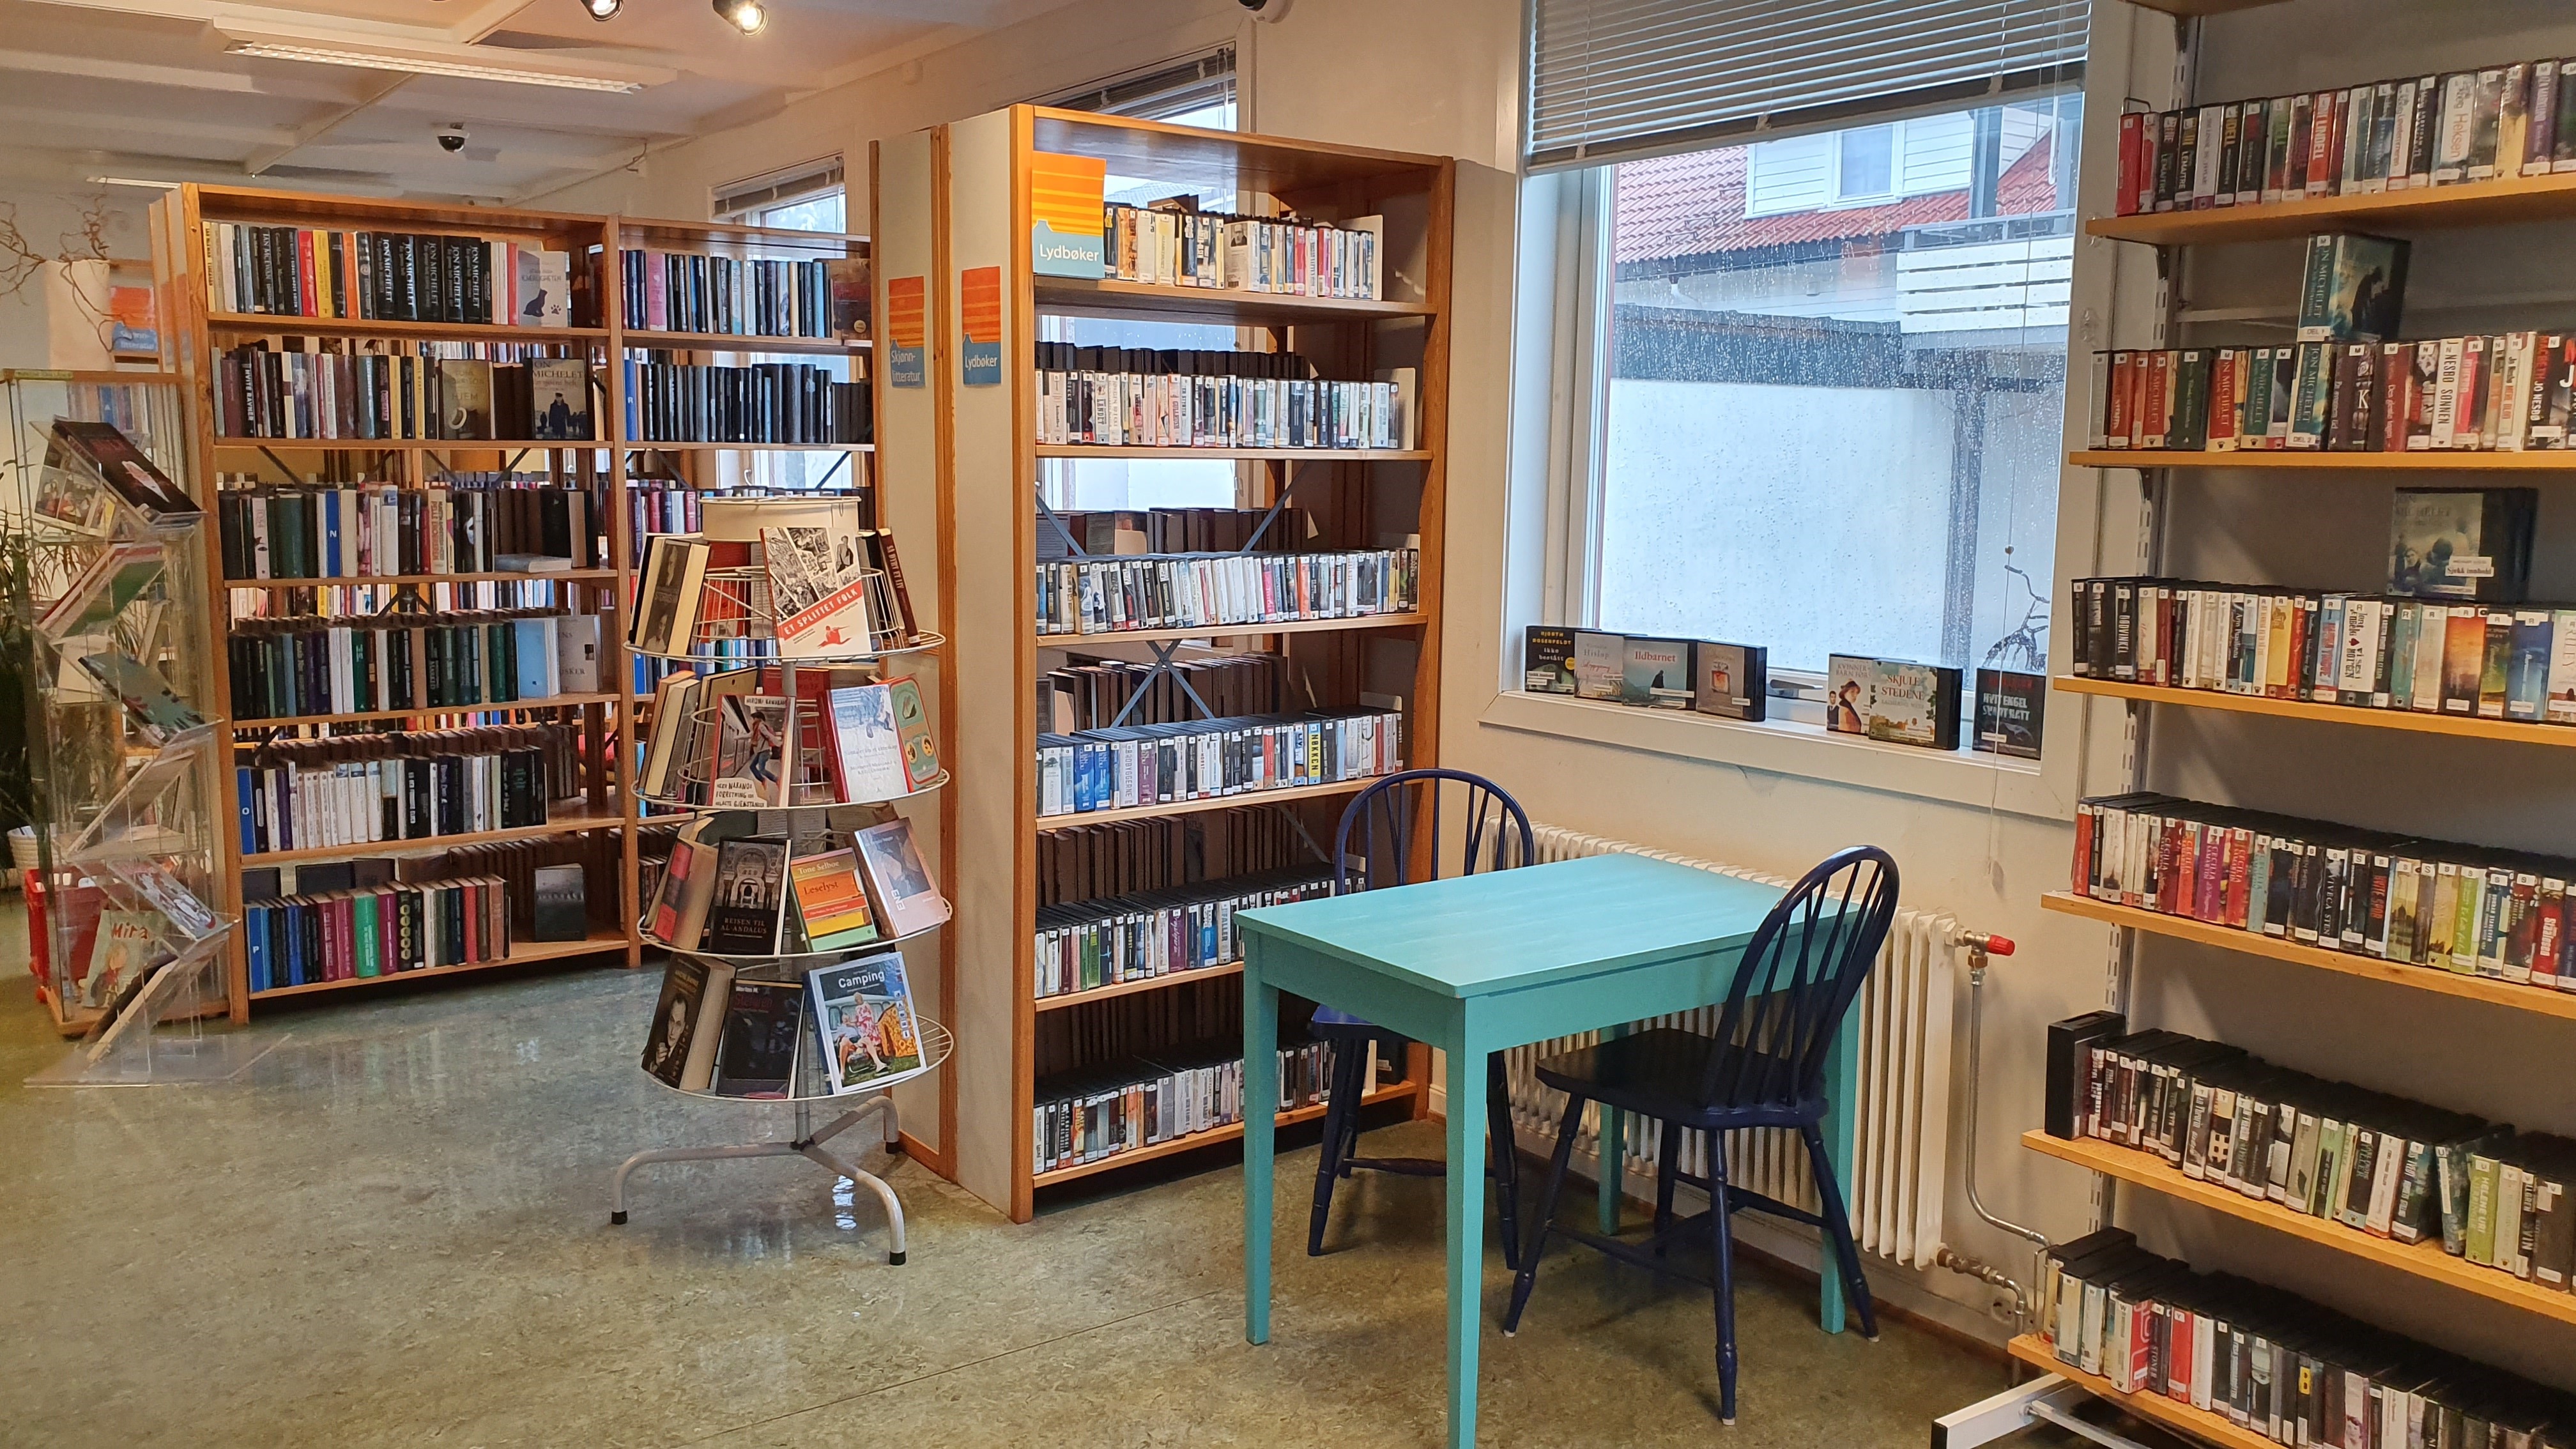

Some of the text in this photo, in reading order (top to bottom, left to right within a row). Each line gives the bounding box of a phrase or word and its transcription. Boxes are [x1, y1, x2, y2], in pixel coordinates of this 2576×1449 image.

[2450, 113, 2468, 158] Heksen
[1039, 244, 1099, 262] Lydbøker
[891, 349, 916, 364] Skjønn-
[965, 355, 997, 369] Lydbøker
[533, 371, 583, 379] MICHELET
[892, 369, 921, 383] litteratur
[784, 588, 858, 634] ET SPLITTET FOLK
[1634, 650, 1676, 662] Ildbarnet
[1881, 687, 1926, 701] STEDENE
[2004, 695, 2027, 709] ENGEL
[242, 807, 250, 815] O
[798, 861, 839, 875] Tone Selboe
[804, 881, 838, 895] Leselyst
[2323, 875, 2336, 936] VIVECA STEN
[252, 946, 259, 954] P
[838, 971, 885, 988] Camping
[2478, 1177, 2489, 1234] HELENE URI
